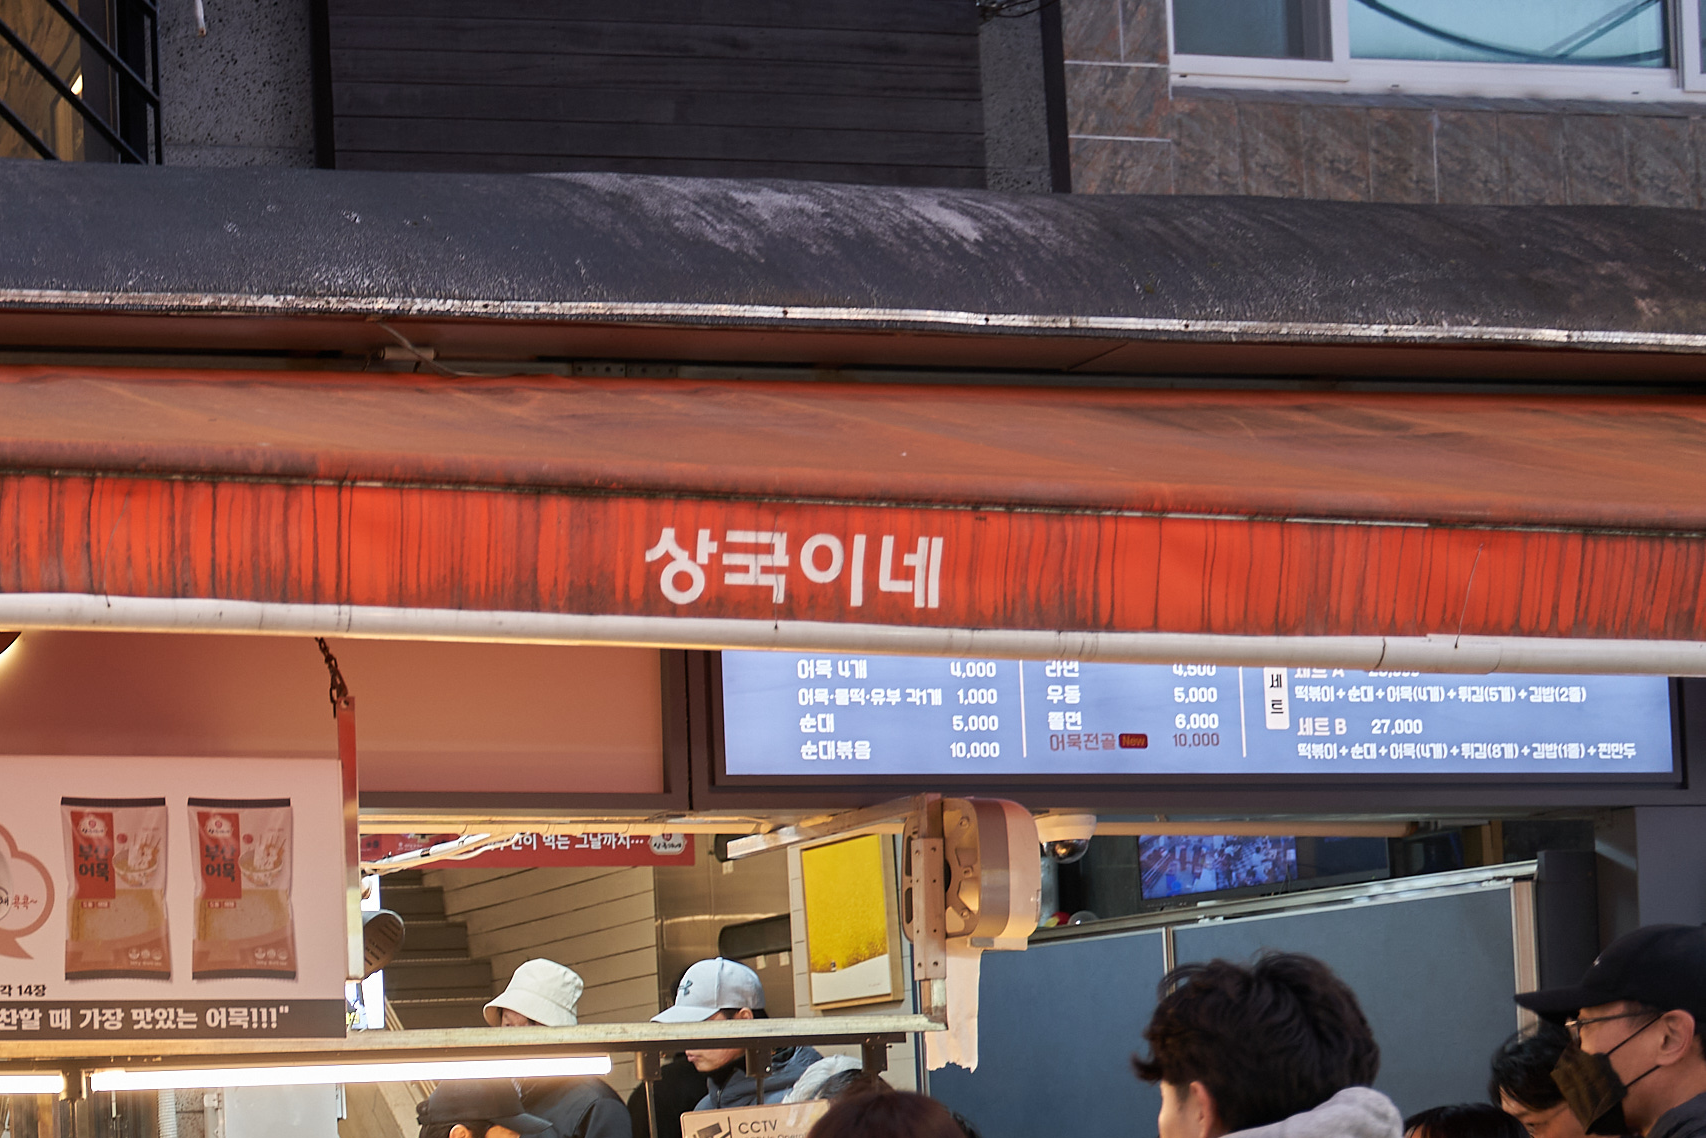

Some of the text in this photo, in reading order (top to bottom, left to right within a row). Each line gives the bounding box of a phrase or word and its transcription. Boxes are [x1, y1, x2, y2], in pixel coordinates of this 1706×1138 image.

[645, 527, 944, 608] 상국이네
[797, 659, 996, 679] 어묵 4개 4,000
[956, 688, 997, 705] 1,000
[1047, 685, 1217, 704] 우동 5,000
[1294, 685, 1334, 702] 떡볶이
[1347, 686, 1374, 702] 순대
[799, 713, 999, 733] 순대 5,000
[1047, 711, 1219, 731] 쫄면 6,000
[1297, 717, 1423, 736] 세트 B 27,000
[801, 740, 1000, 760] 순대볶음 10,000
[1050, 733, 1220, 751] 어묵전골 New 10,000
[1298, 743, 1338, 760] 떡볶이
[1351, 743, 1376, 759] 순대
[17, 984, 47, 997] 14장
[48, 1008, 72, 1030] 때
[79, 1008, 124, 1030] 가장
[130, 1007, 199, 1030] 맛있는
[738, 1119, 778, 1134] CCTV
